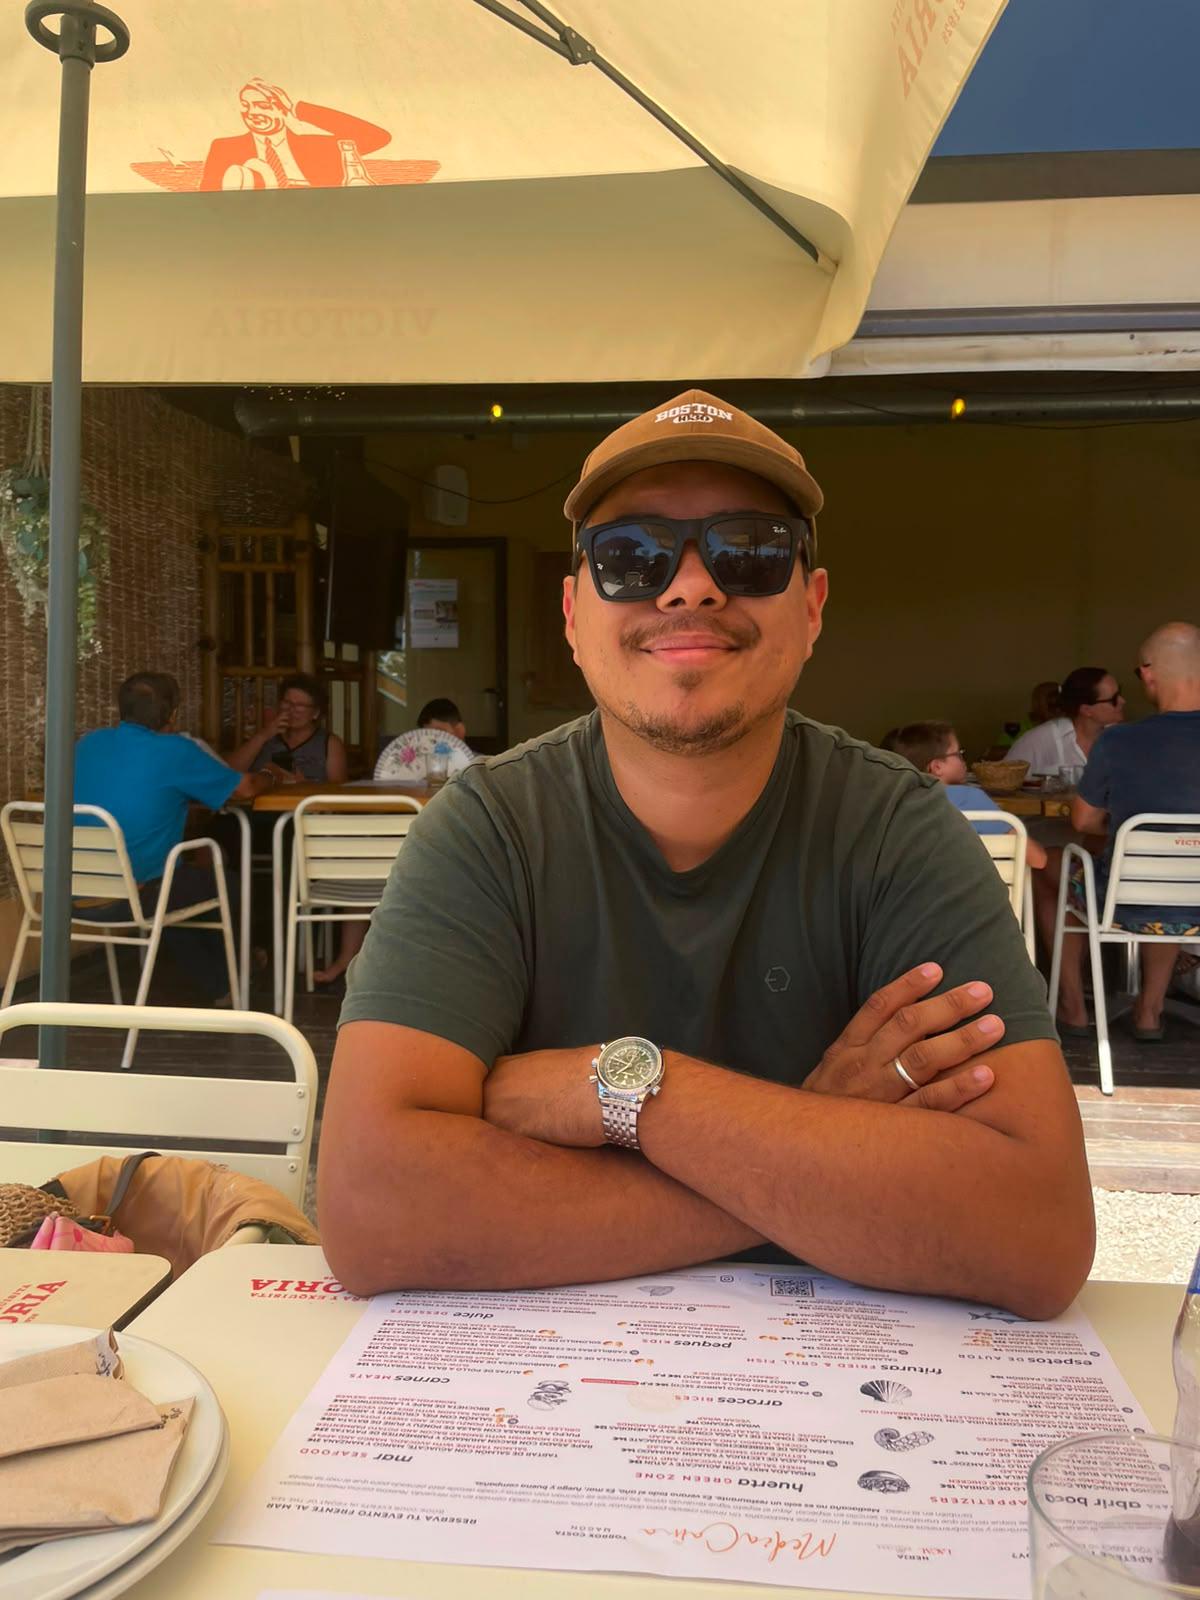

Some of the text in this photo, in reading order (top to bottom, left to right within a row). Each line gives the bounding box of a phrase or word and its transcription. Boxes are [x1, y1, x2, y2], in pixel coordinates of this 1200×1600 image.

[654, 402, 734, 424] BOSTON
[1174, 838, 1200, 847] VICT
[390, 1308, 494, 1320] dulce DESSERTS
[673, 1340, 732, 1349] peques
[782, 1360, 818, 1368] GRILL
[838, 1362, 875, 1370] FRIED
[880, 1364, 943, 1375] frituras
[350, 1372, 450, 1384] carnes MEATS
[674, 1394, 783, 1407] arroces RICES
[811, 1438, 854, 1446] ENSALADA
[298, 1447, 412, 1464] mar SEAFOOD
[781, 1457, 825, 1466] ENSALADA
[770, 1468, 816, 1477] ENSALADA
[635, 1472, 804, 1493] huerta GREEN ZONE
[671, 1492, 700, 1501] verano
[930, 1496, 1027, 1507] APPETIZERS
[1045, 1494, 1088, 1506] boca
[266, 1502, 292, 1511] MAR
[1094, 1498, 1141, 1510] abrir
[312, 1506, 355, 1516] FRENTE
[358, 1510, 403, 1520] EVENTO
[425, 1515, 477, 1525] RESERVA
[554, 1530, 586, 1538] COSTA
